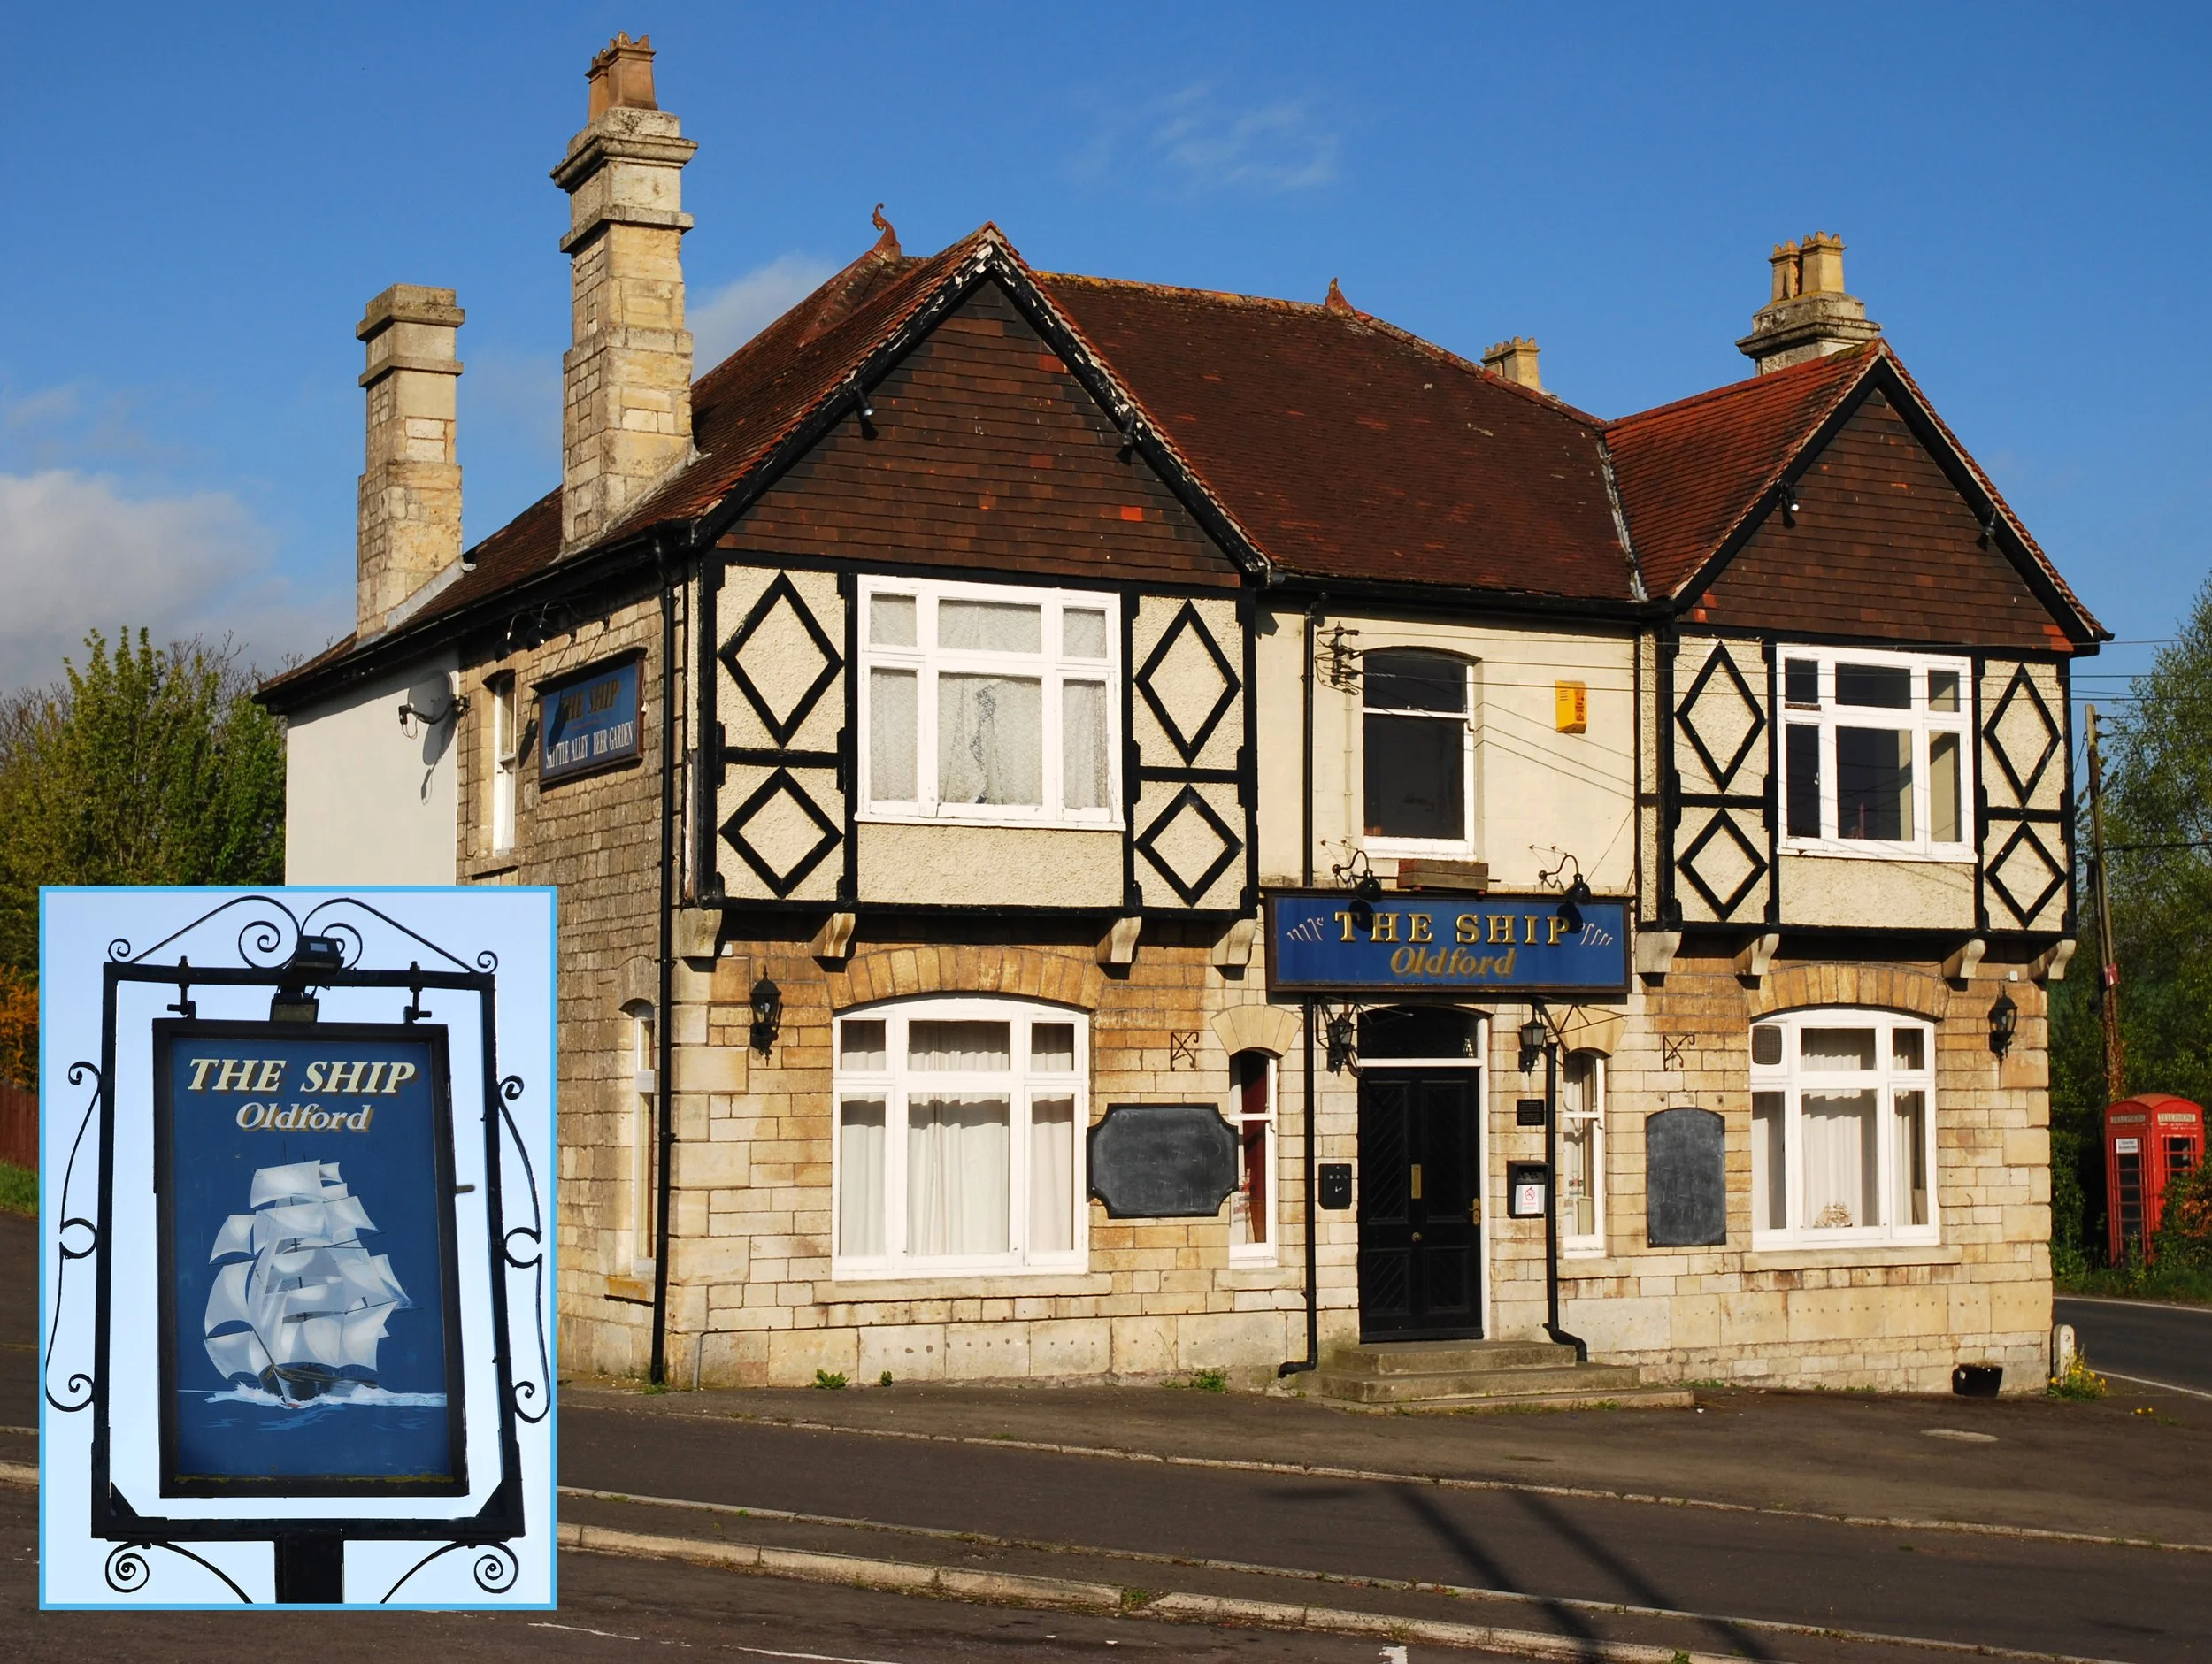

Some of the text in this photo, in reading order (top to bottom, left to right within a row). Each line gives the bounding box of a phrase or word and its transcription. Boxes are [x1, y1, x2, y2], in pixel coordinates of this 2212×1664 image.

[561, 679, 619, 722] THE SHIP
[546, 720, 634, 769] SKITTLE ALLEY BEER GARDEN
[1334, 911, 1570, 945] THE SHIP
[1390, 946, 1517, 978] Oldford
[188, 1058, 417, 1095] THE SHIP
[235, 1102, 373, 1131] Oldford
